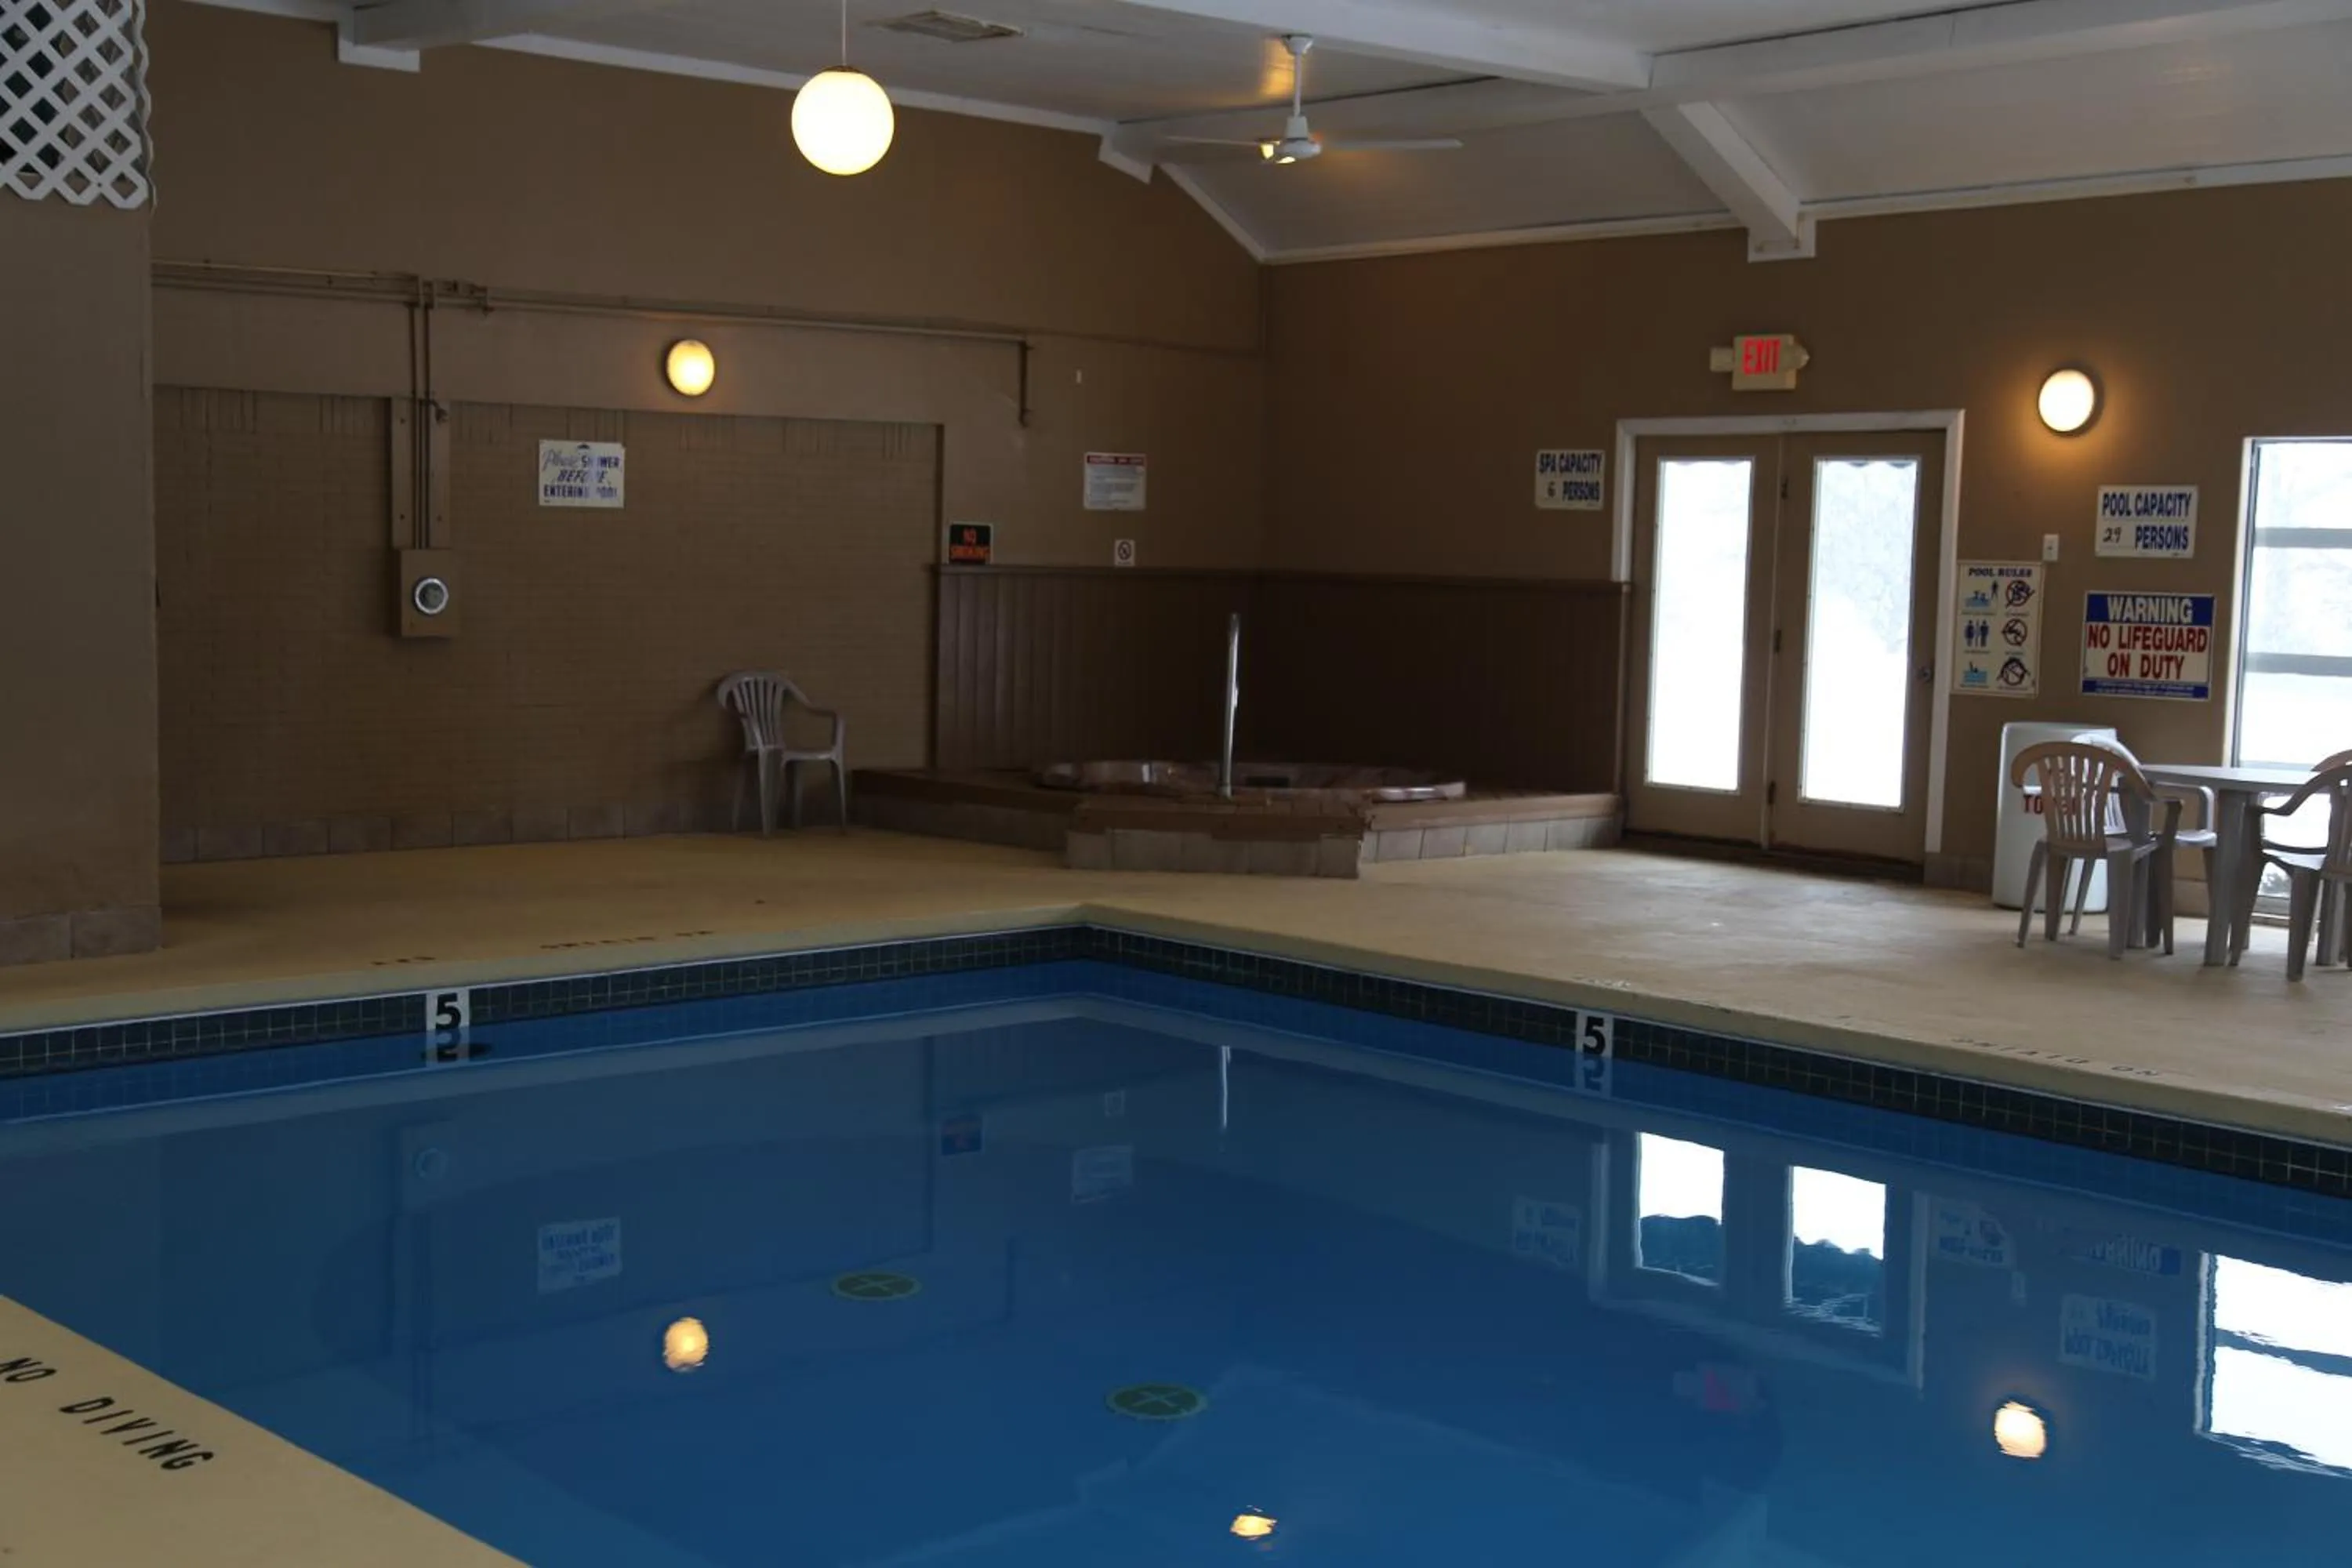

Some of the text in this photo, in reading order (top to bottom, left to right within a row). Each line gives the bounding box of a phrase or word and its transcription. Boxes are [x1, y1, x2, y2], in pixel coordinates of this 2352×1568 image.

[1741, 338, 1780, 376] EXIT
[1539, 452, 1602, 474] SPA CAPACITY
[1563, 480, 1600, 502] PERSONS
[2102, 492, 2192, 517] POOL CAPACITY
[2135, 525, 2189, 550] PERSONS
[1969, 567, 1994, 577] POOL
[2107, 596, 2193, 624] WARNING
[2087, 625, 2208, 652] NO LIFEGUARD
[2107, 653, 2184, 680] ON DUTY
[436, 993, 461, 1029] 5
[1583, 1016, 1606, 1054] 5
[0, 1357, 213, 1469] NO DIVING
